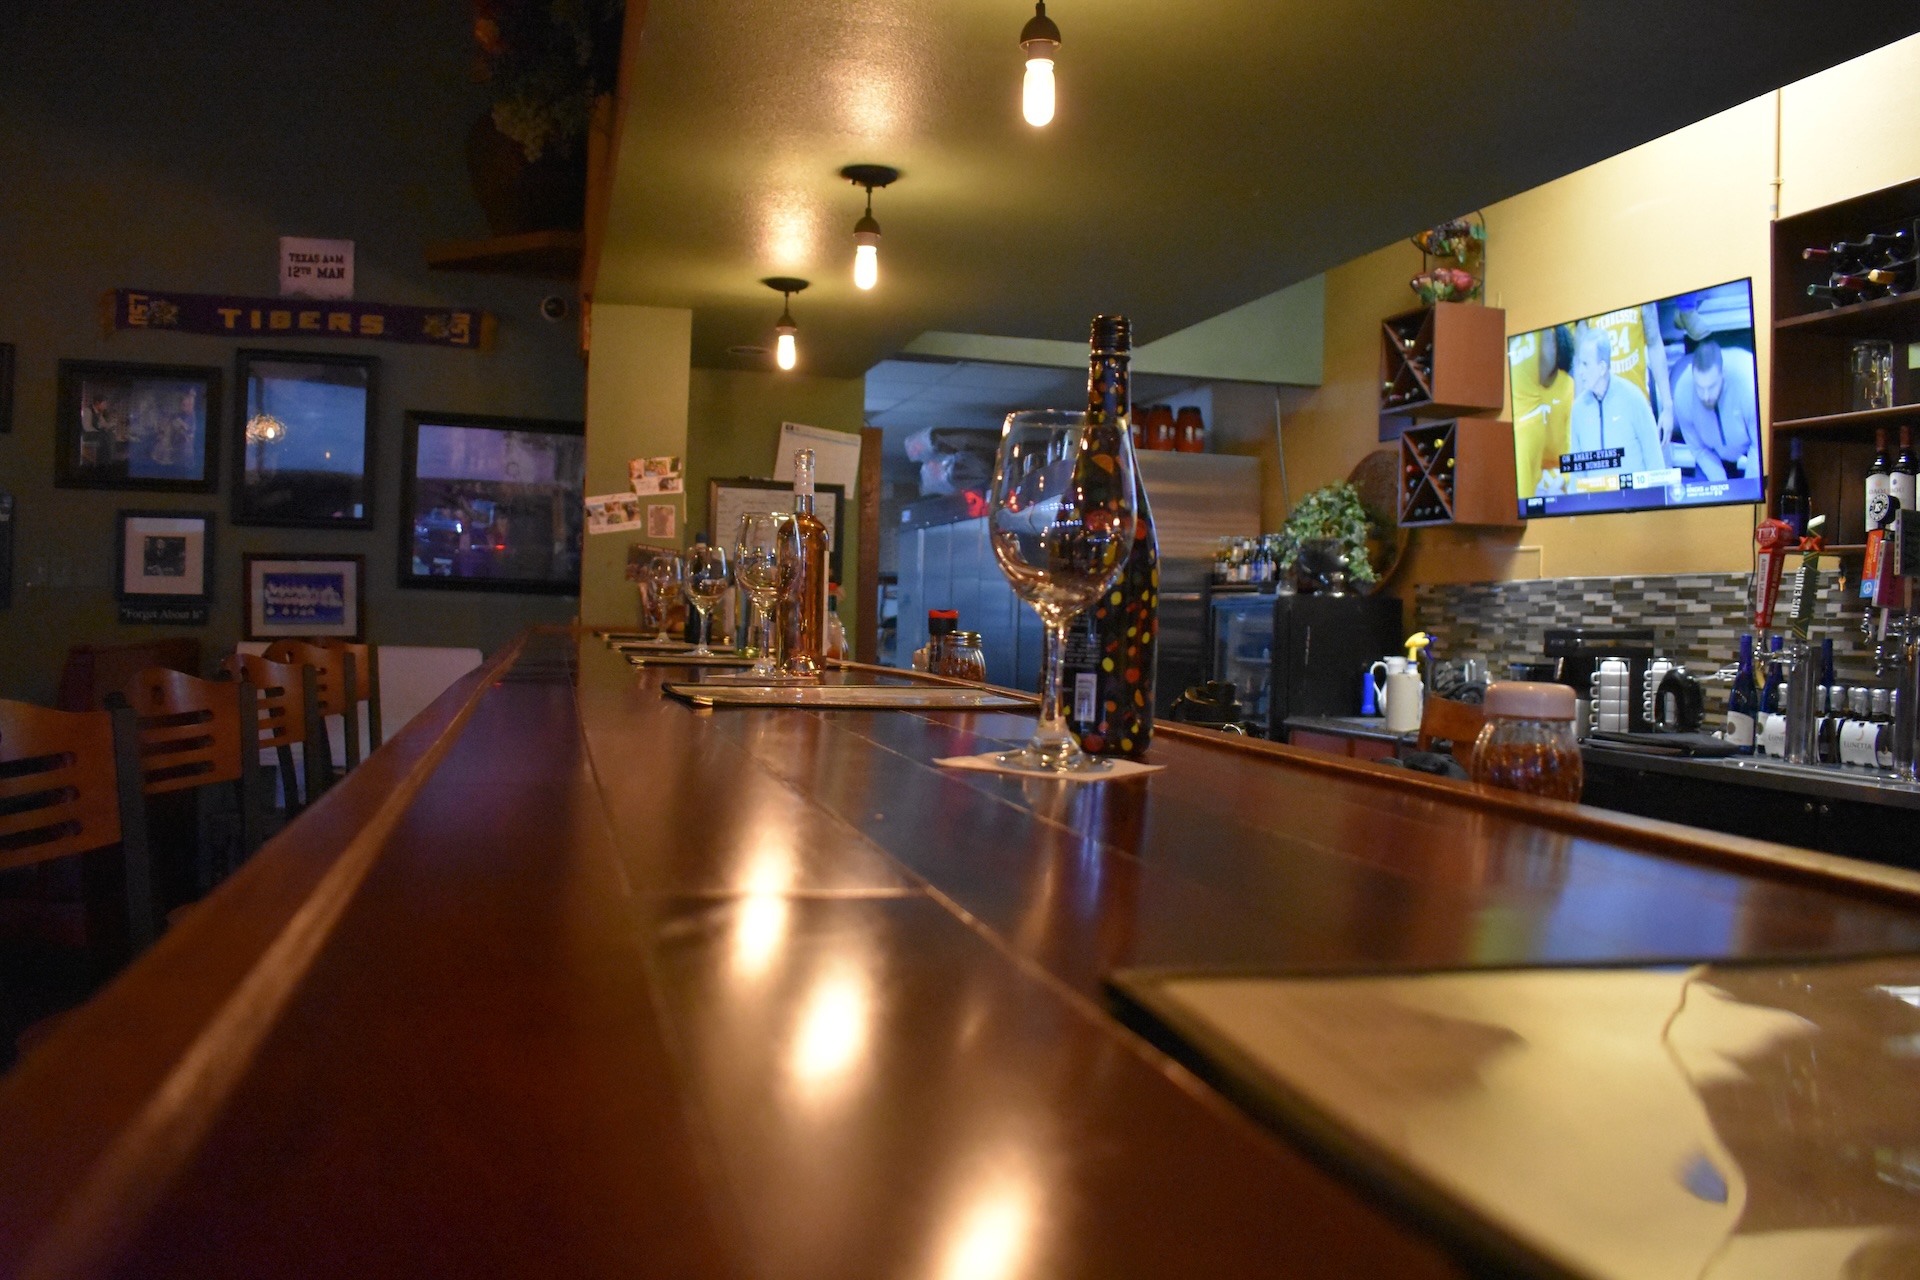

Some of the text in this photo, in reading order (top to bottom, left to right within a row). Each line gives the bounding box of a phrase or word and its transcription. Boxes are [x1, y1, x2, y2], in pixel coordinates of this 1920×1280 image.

[289, 253, 320, 263] TEXAS
[317, 267, 345, 279] MAN
[1585, 459, 1607, 470] NUMBER
[1789, 566, 1806, 618] DOS EQUIS
[1843, 740, 1872, 750] LUNETTA
